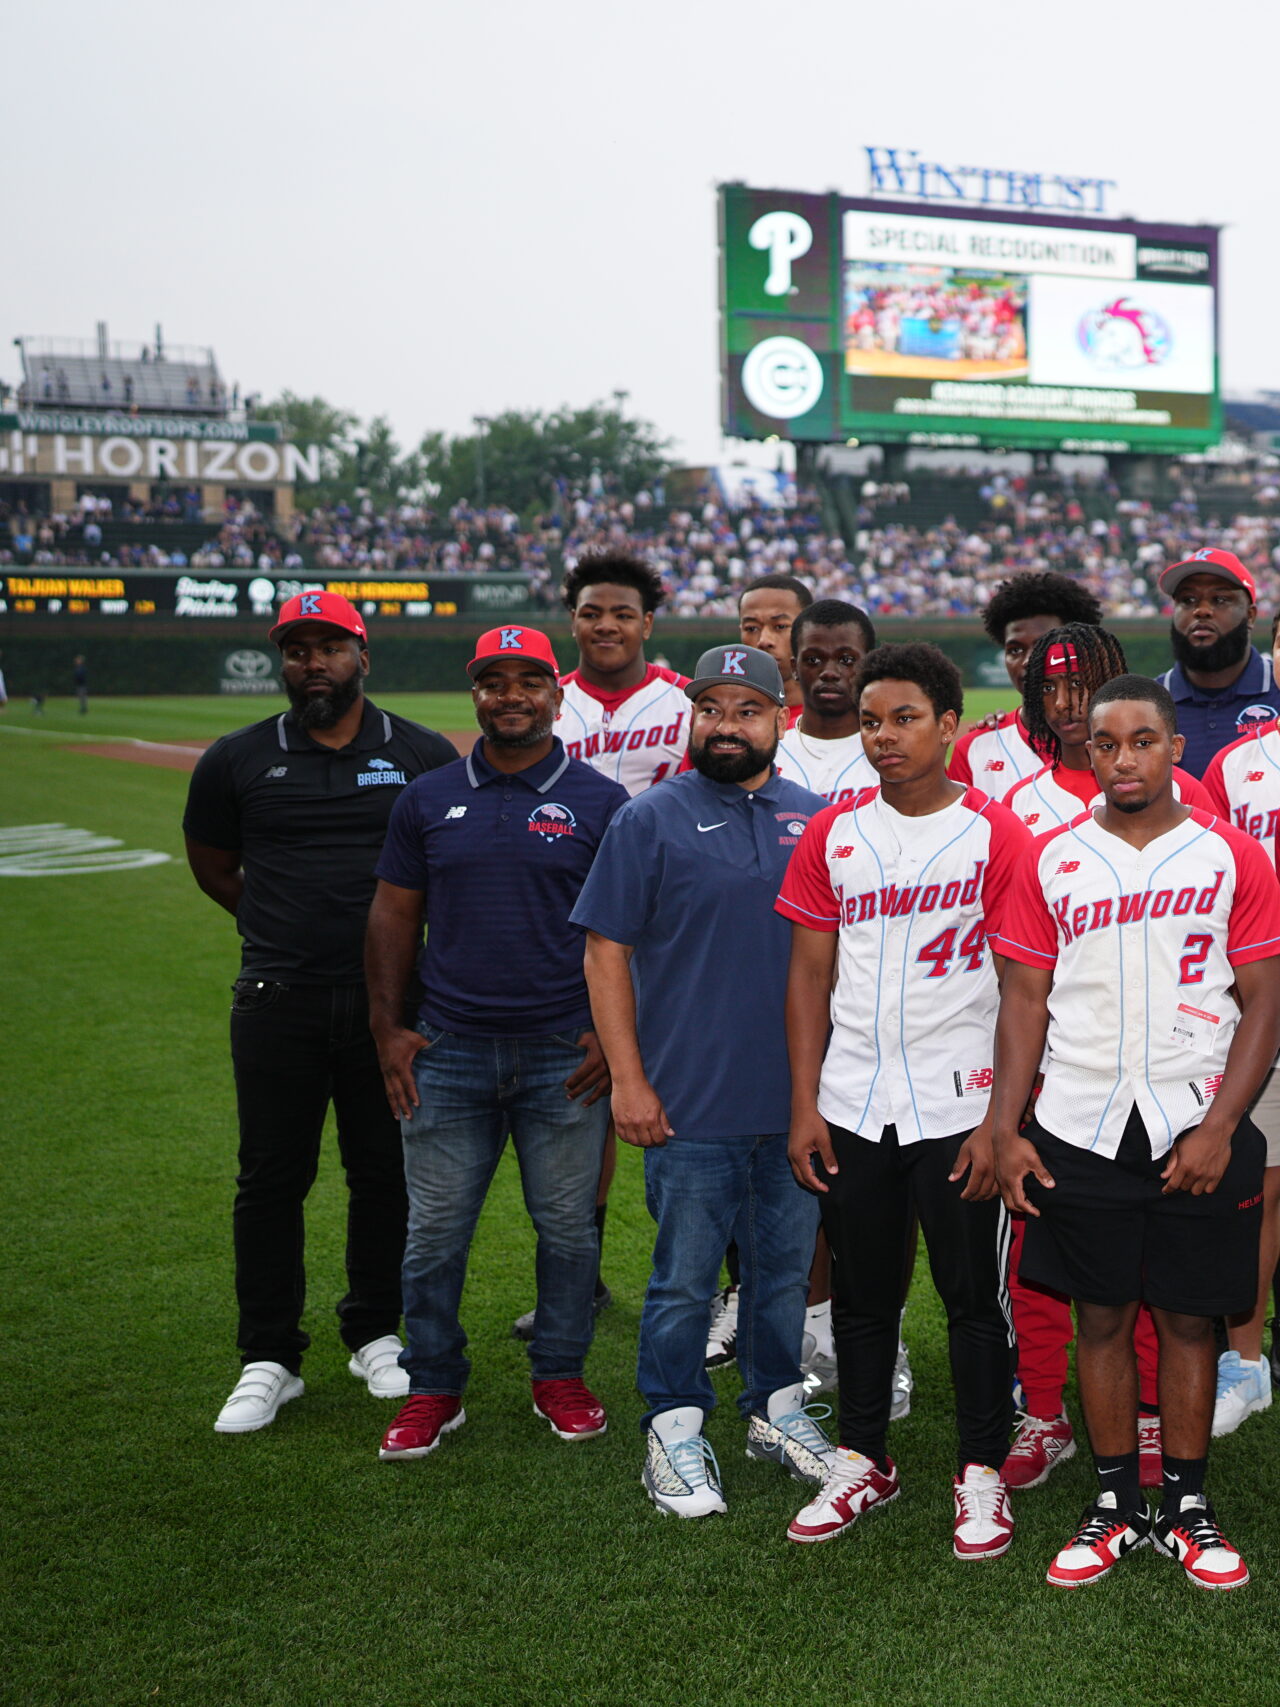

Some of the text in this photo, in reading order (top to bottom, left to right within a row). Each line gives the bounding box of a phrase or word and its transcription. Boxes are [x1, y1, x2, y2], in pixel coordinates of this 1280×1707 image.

[867, 226, 958, 253] SPECIAL
[970, 234, 1117, 265] RECOGNITION
[53, 433, 321, 483] HORIZON
[300, 595, 322, 615] K
[500, 629, 523, 649] K
[721, 651, 748, 676] K
[220, 678, 281, 693] TOYOTA
[265, 766, 288, 779] NB
[984, 759, 1004, 772] NB
[357, 771, 407, 787] BASEBALL
[1243, 770, 1264, 783] NB
[444, 806, 467, 820] NB
[528, 821, 575, 836] BASEBALL
[831, 845, 855, 859] NB
[1055, 860, 1080, 875] NB
[1052, 870, 1227, 948] Kenwood
[915, 918, 987, 980] 44
[1177, 933, 1215, 987] 2
